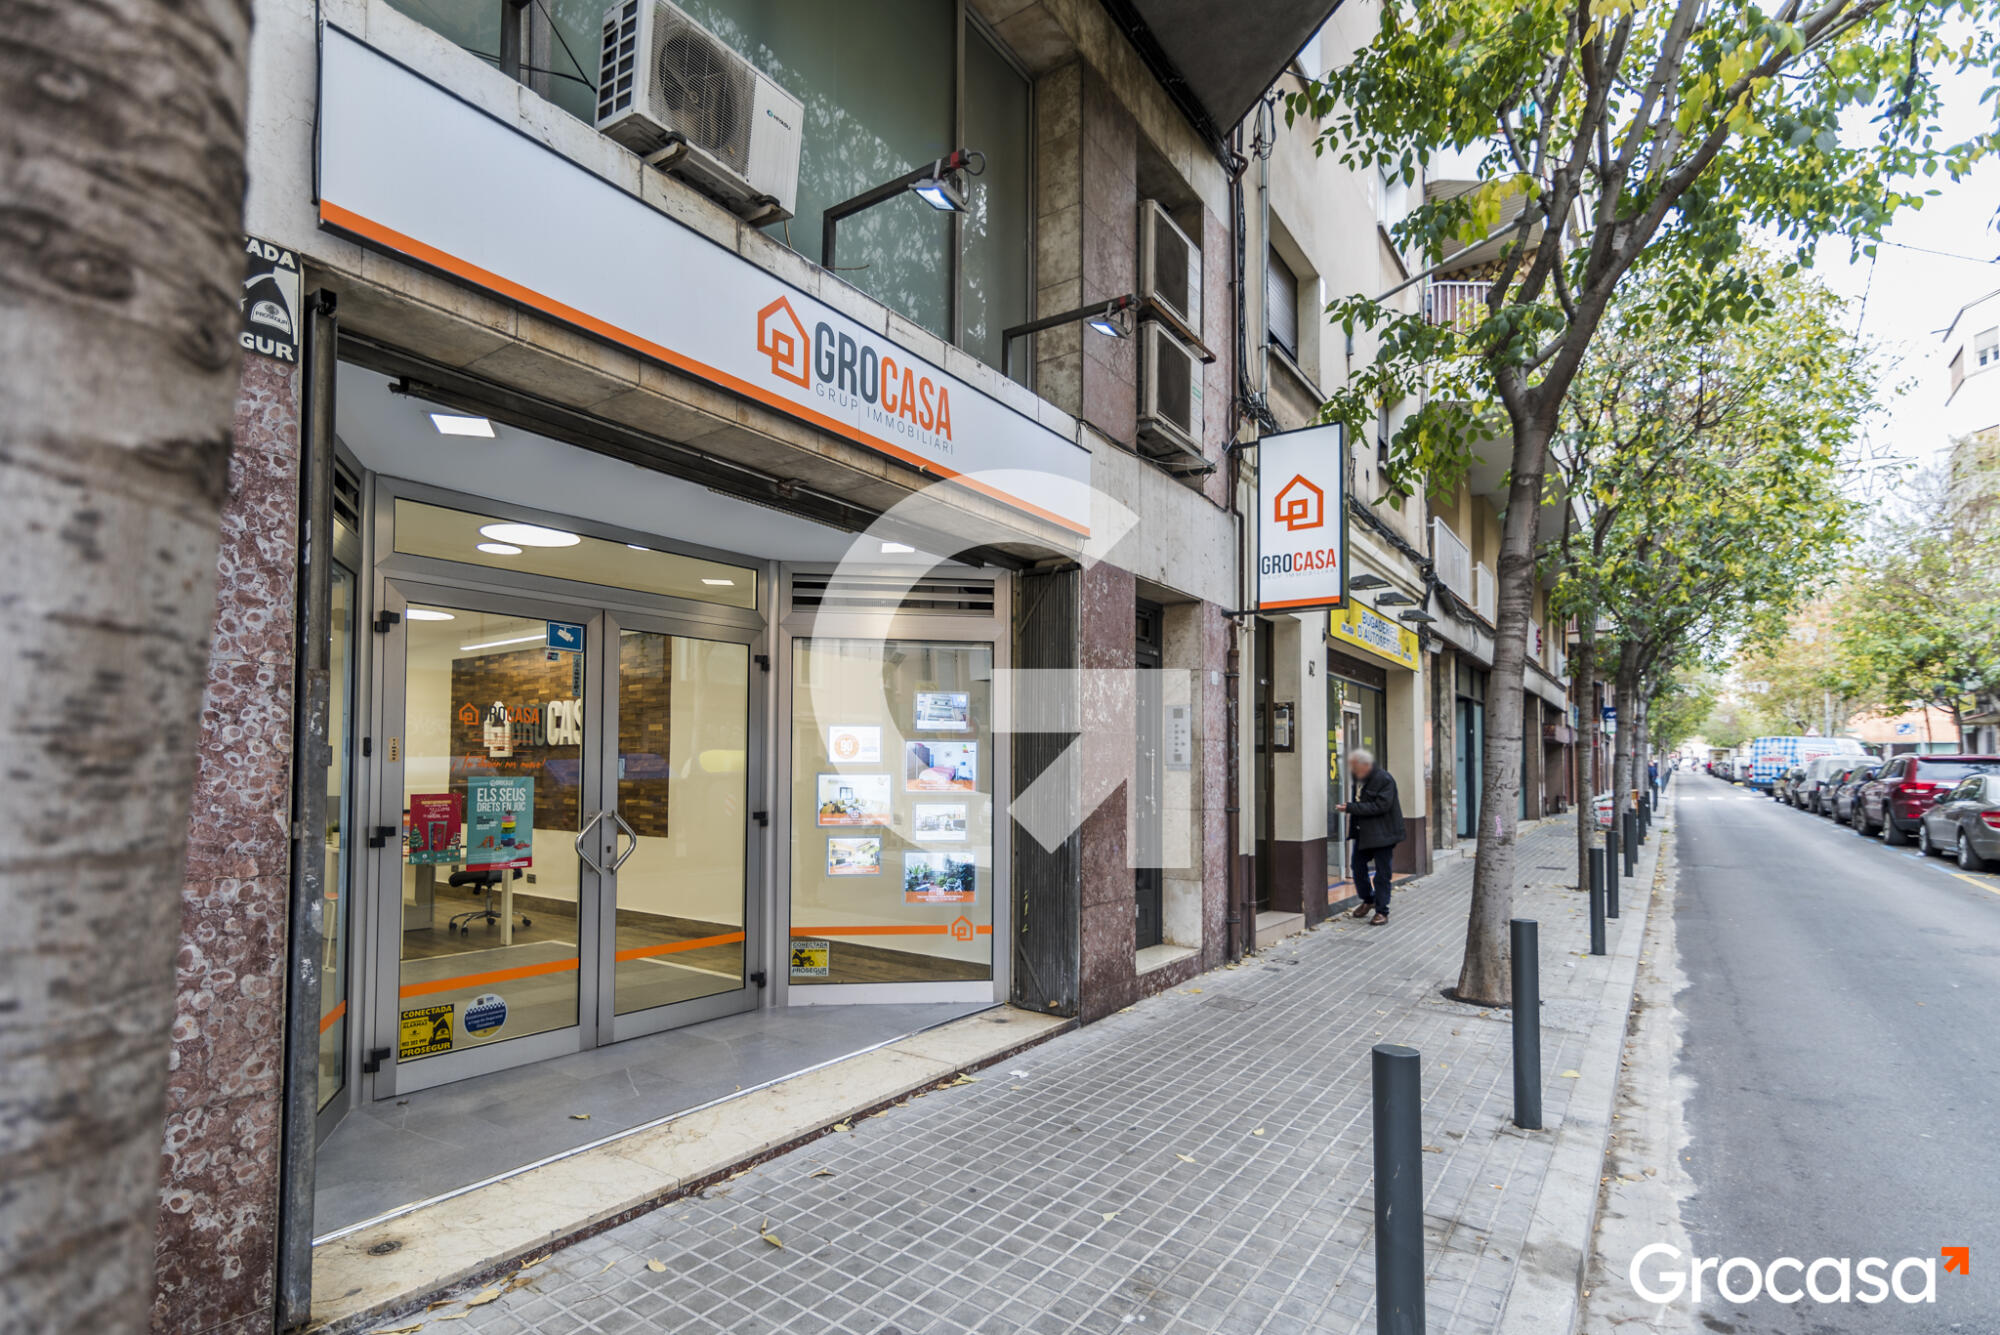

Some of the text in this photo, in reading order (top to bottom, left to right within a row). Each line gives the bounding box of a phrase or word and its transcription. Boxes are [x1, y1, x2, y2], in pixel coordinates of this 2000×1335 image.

[246, 237, 296, 269] ADA
[815, 321, 952, 441] GROCASA
[815, 383, 954, 455] GRUP IMMOBILIARI
[1261, 548, 1337, 575] GROCASA
[477, 787, 526, 802] ELS SEUS
[476, 801, 500, 812] DRETS
[403, 1005, 452, 1019] CONECTADA
[401, 1042, 451, 1057] PROSEGUR
